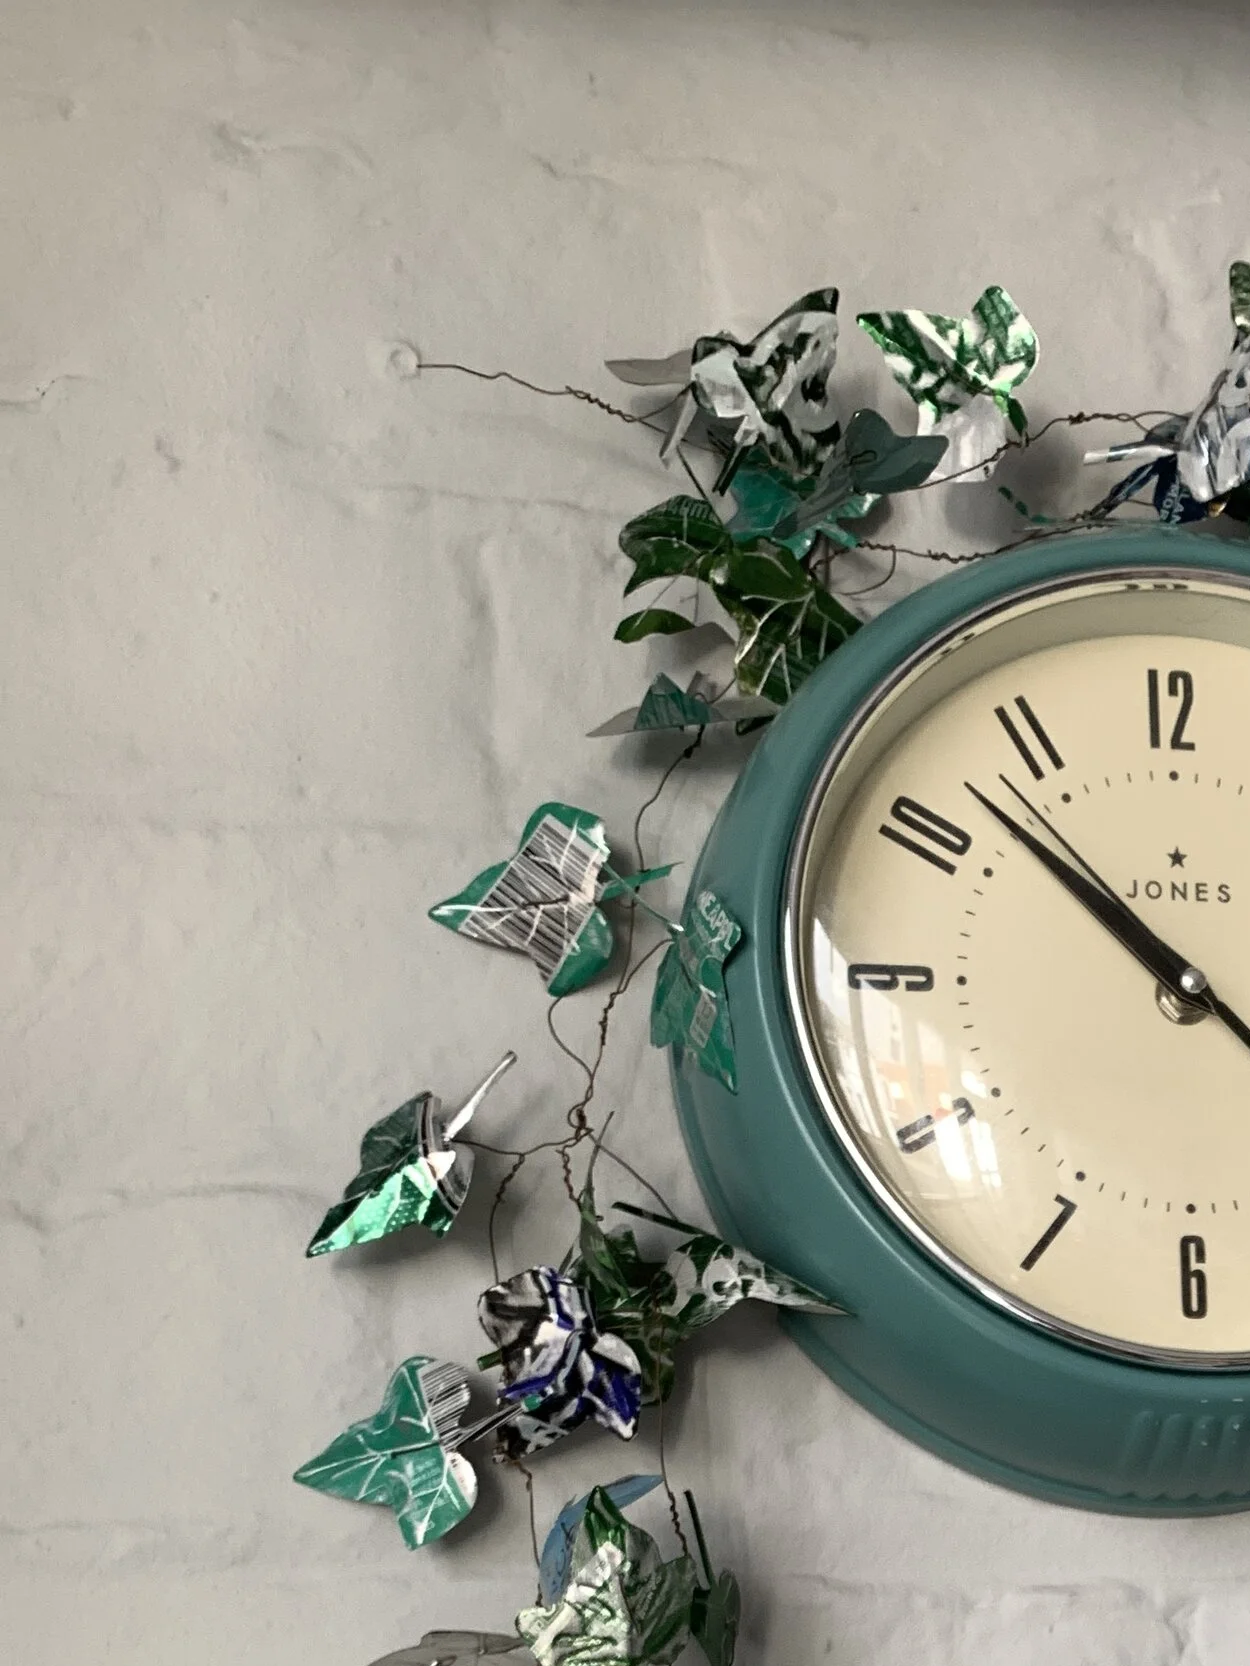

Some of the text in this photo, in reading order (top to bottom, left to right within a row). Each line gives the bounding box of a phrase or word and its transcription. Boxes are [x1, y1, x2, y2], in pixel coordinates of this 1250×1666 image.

[993, 695, 1065, 781] 11
[1147, 668, 1197, 751] 12
[878, 795, 972, 876] 10
[1125, 879, 1232, 904] JONES
[847, 963, 935, 992] 9
[1019, 1194, 1077, 1272] 7
[1179, 1235, 1209, 1321] 6
